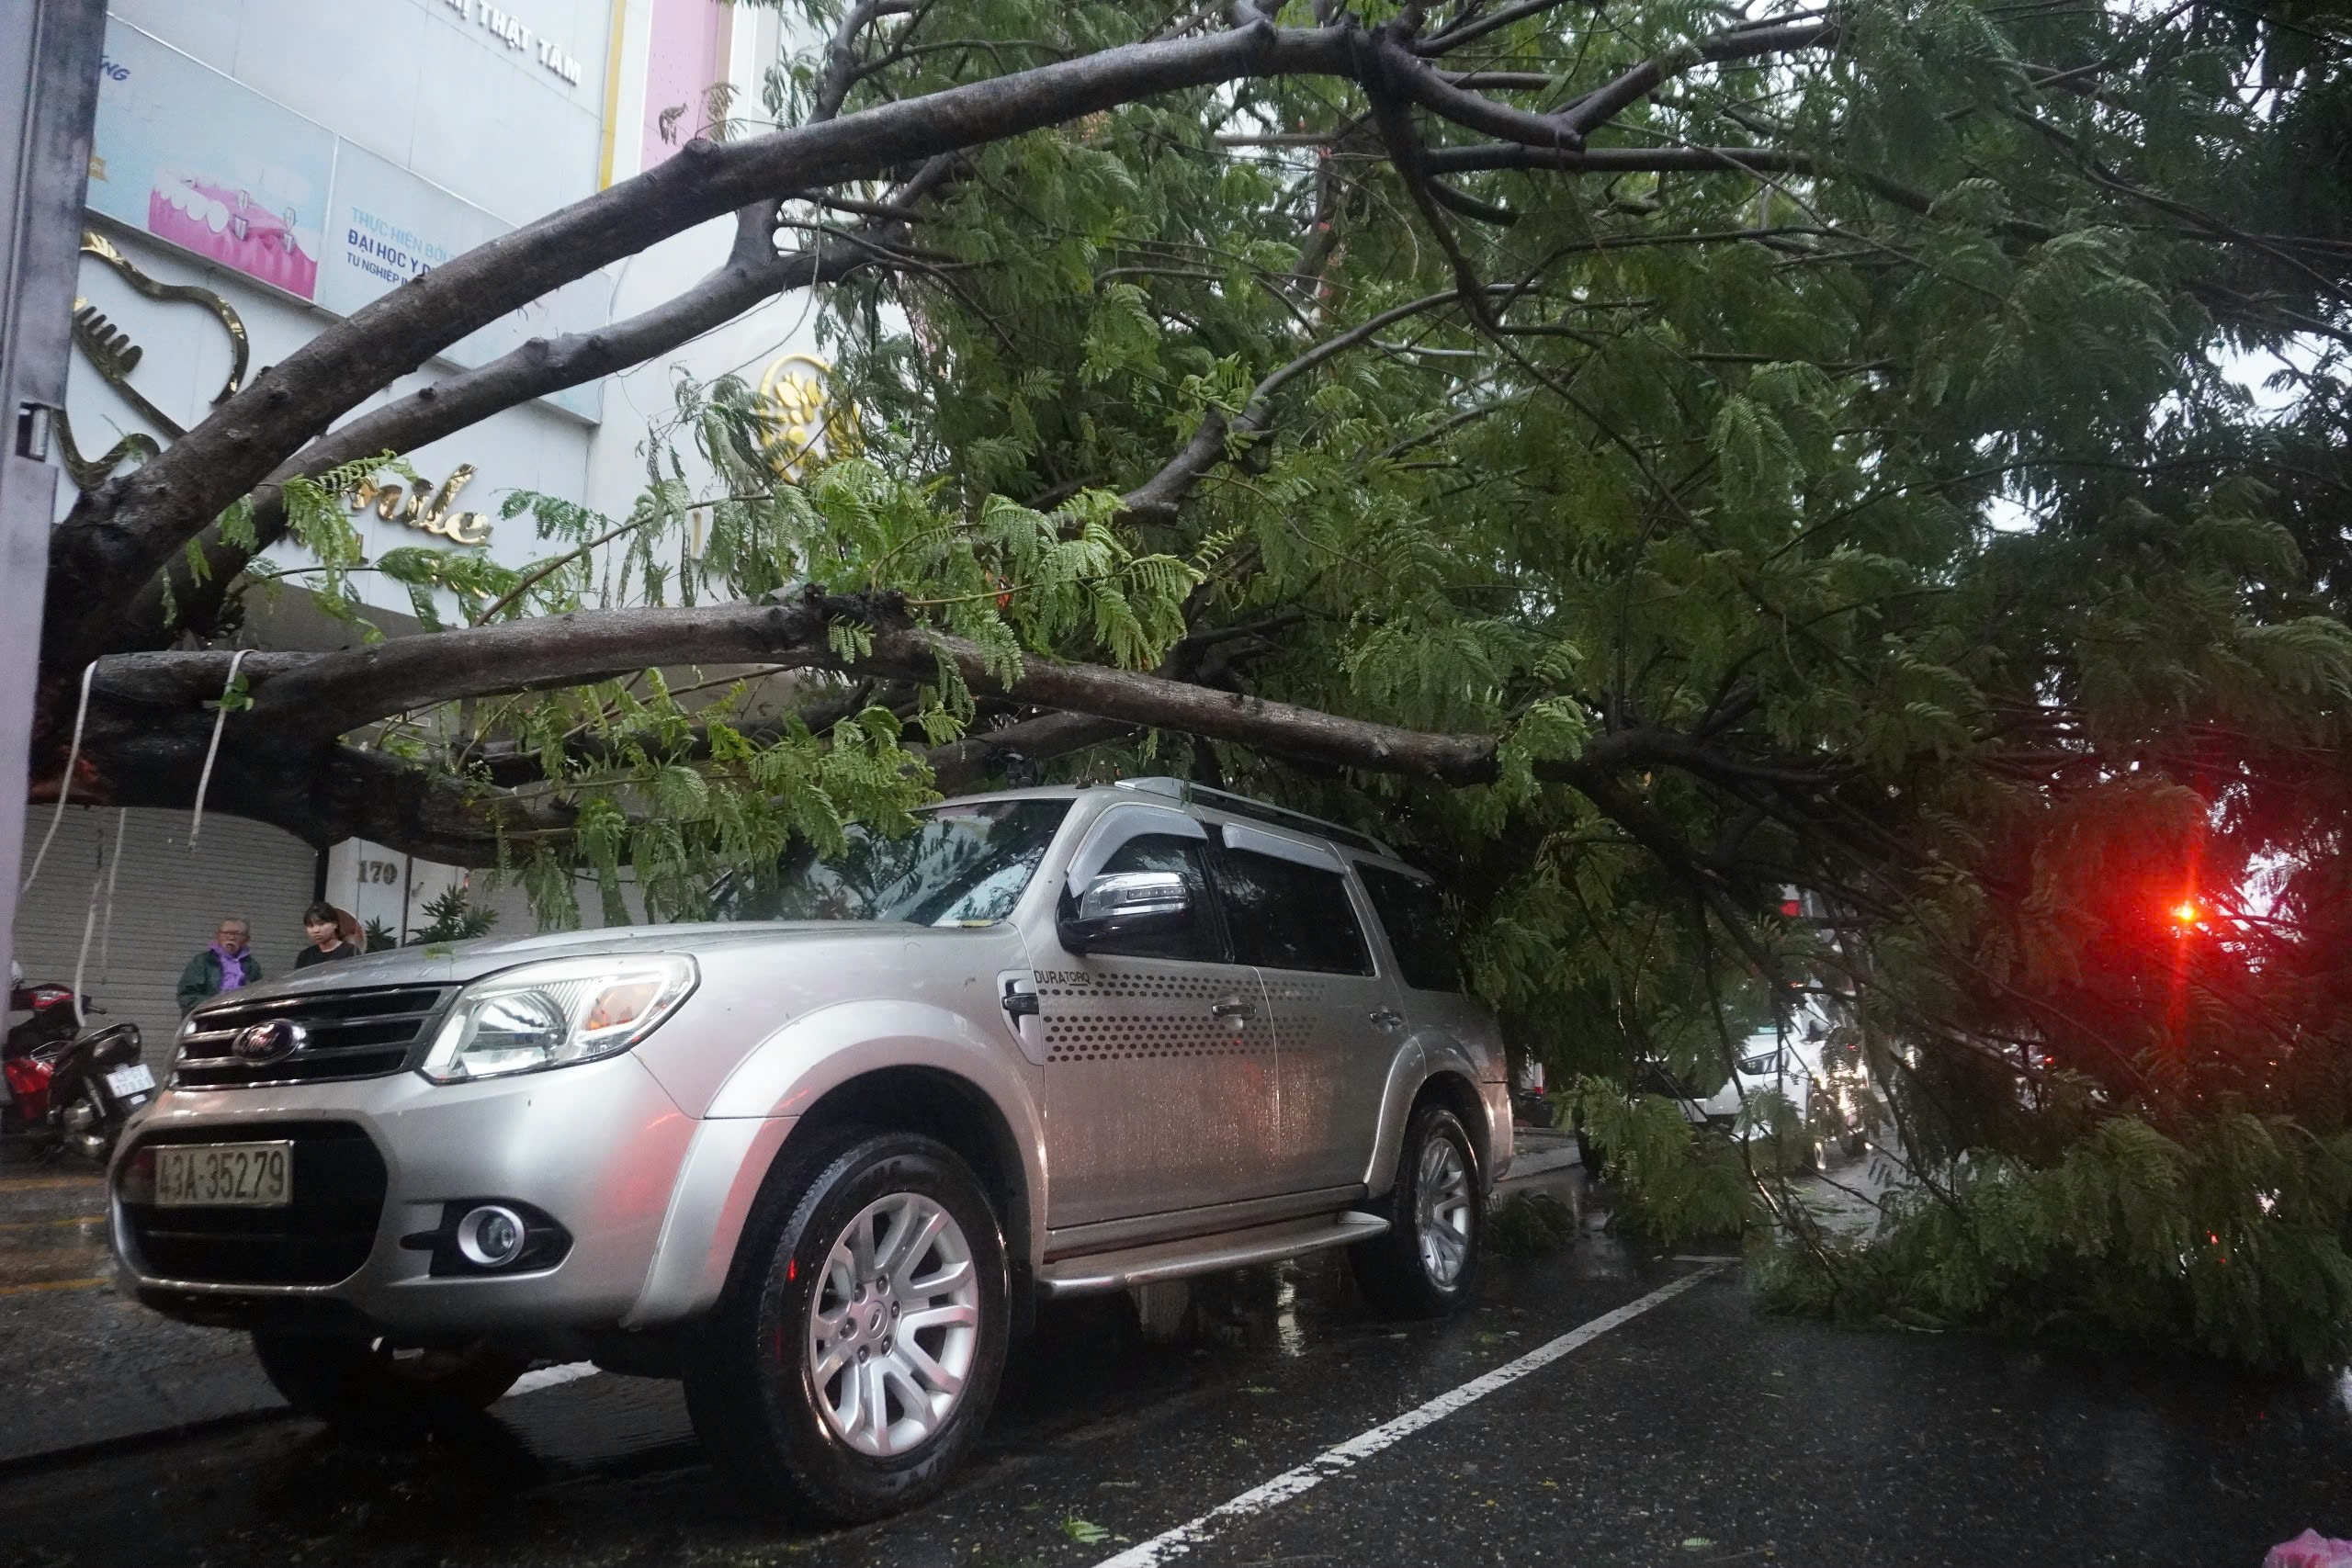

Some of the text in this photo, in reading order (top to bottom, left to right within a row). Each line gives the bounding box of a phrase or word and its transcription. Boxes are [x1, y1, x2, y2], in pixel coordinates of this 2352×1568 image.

[347, 228, 375, 254] ĐẠI
[376, 241, 407, 268] HỌC
[410, 256, 419, 274] Y
[356, 860, 398, 886] 170
[1034, 969, 1091, 987] DURATORQ
